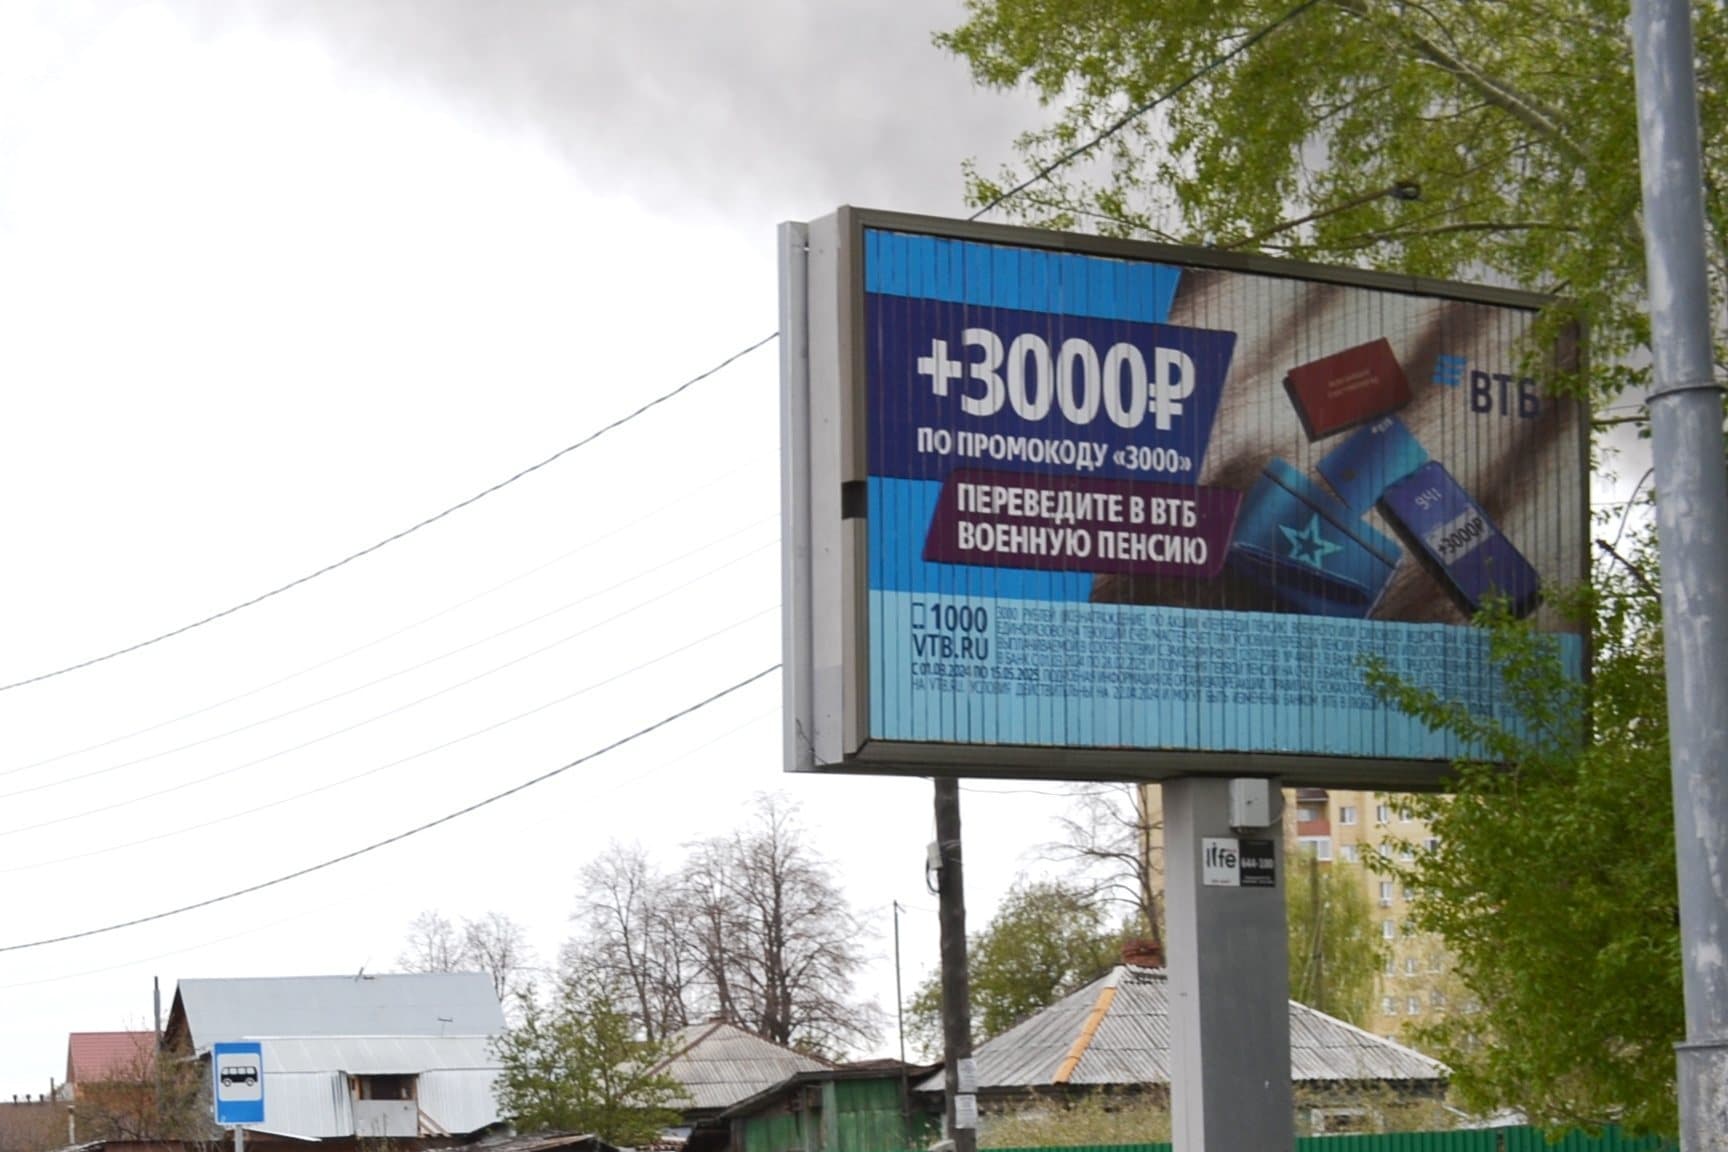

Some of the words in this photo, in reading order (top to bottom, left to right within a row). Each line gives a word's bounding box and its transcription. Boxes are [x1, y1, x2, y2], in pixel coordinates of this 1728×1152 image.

[1471, 370, 1540, 418] ВТБ
[917, 427, 952, 454] ПО
[957, 432, 1108, 471] ПРОМОКОДУ
[1112, 445, 1192, 472] «3000»
[957, 483, 1123, 524] ПЕРЕВЕДИТЕ
[1129, 496, 1145, 523] В
[1151, 498, 1197, 528] ВТБ
[958, 521, 1091, 558] ВОЕННУЮ
[1098, 531, 1208, 565] ПЕНСИЮ
[930, 603, 988, 633] 1000
[911, 633, 989, 660] VTB.RU
